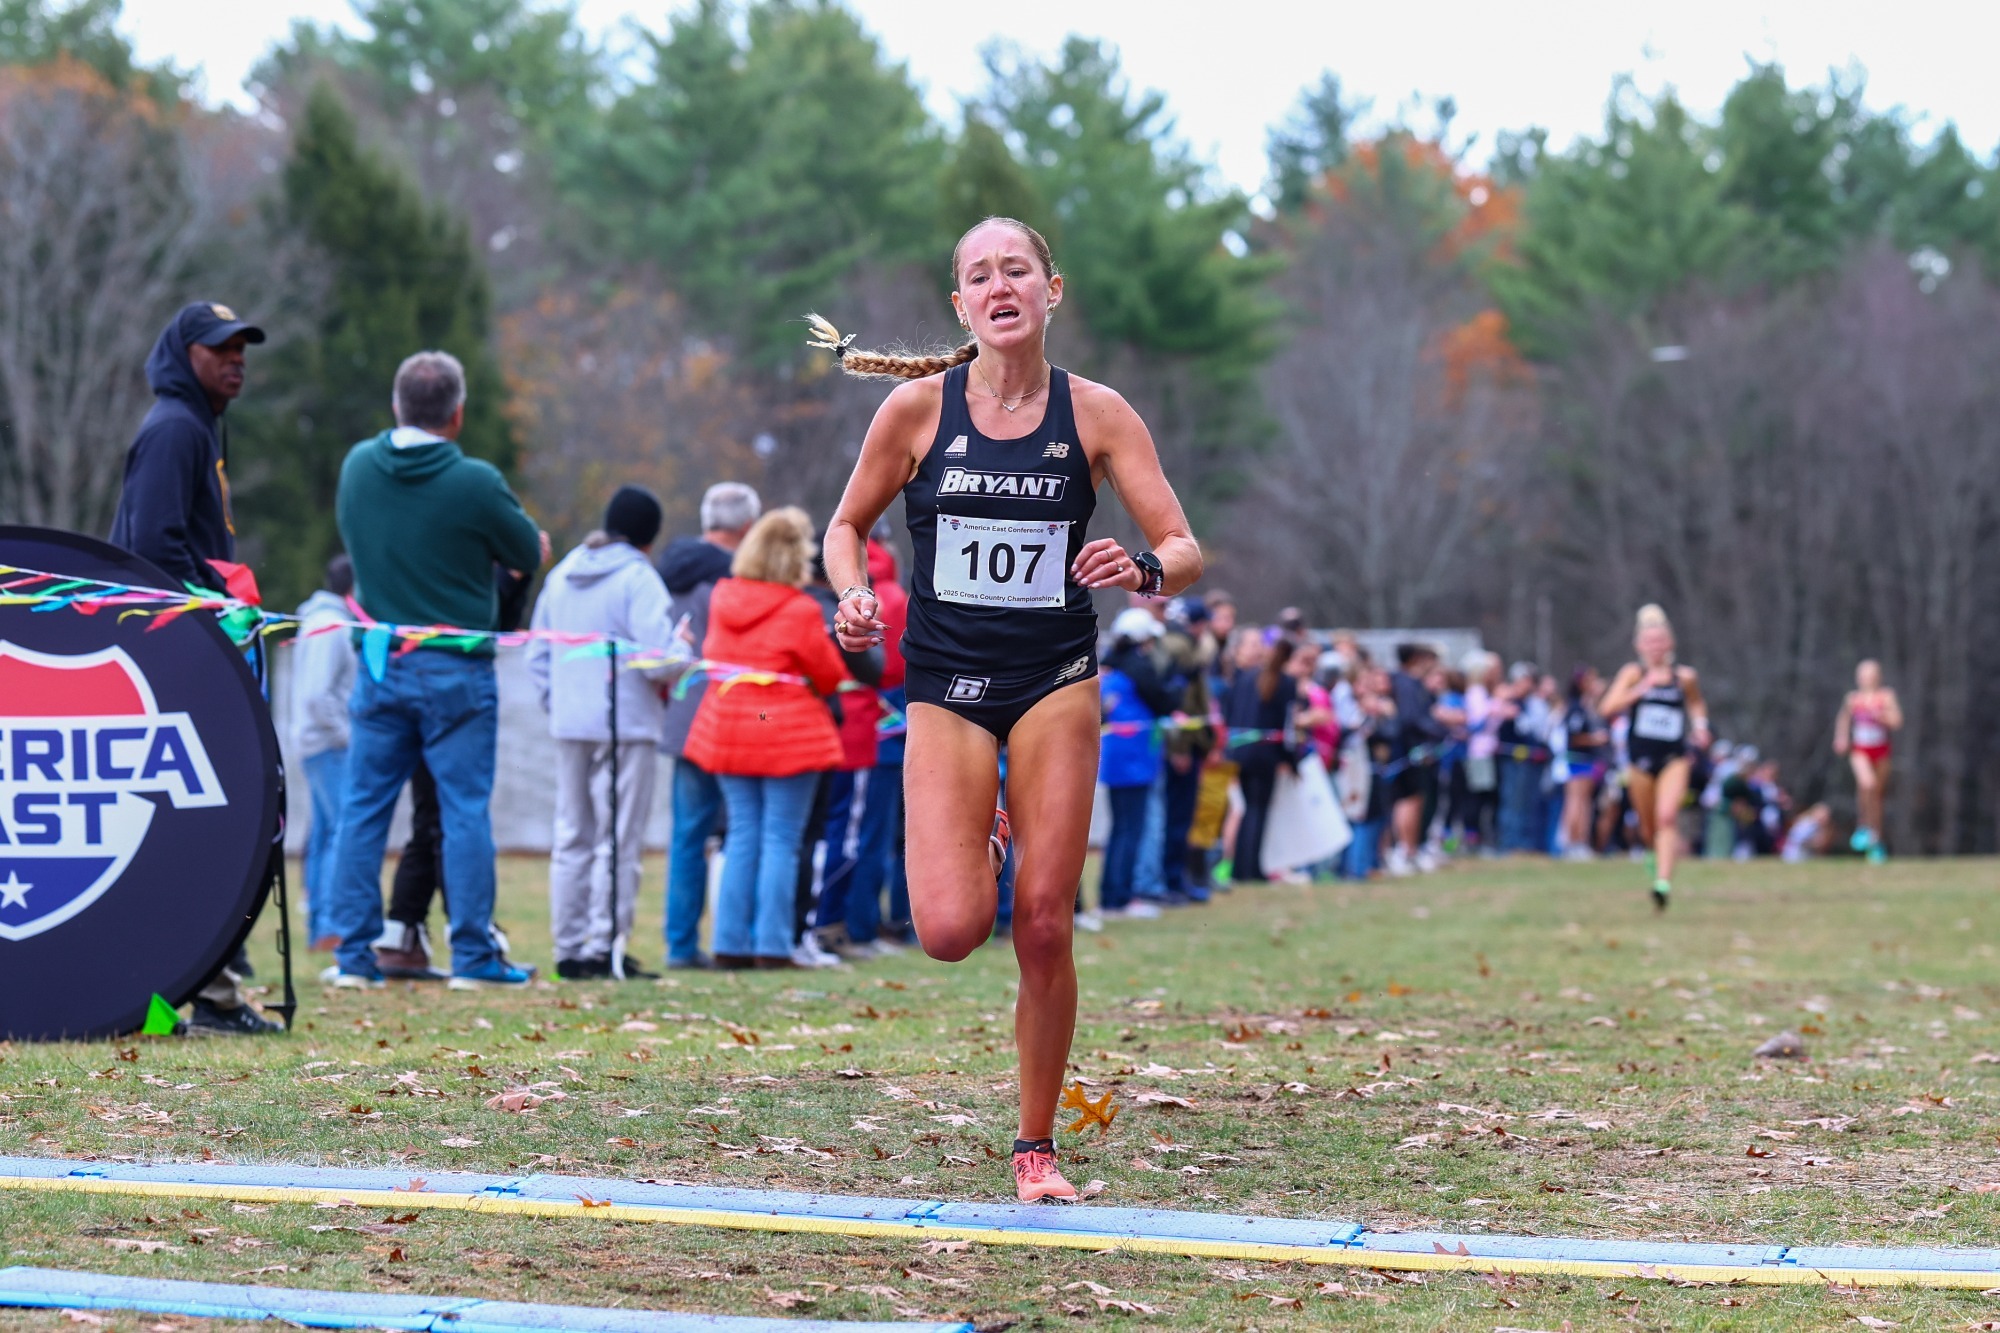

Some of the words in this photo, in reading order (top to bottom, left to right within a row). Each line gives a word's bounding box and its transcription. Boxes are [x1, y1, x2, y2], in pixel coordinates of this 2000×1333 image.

[963, 523, 991, 532] America
[991, 525, 1007, 533] East
[1007, 526, 1044, 534] Conference
[961, 540, 1047, 584] 107
[943, 589, 959, 597] 2025
[959, 591, 979, 600] Cross
[979, 593, 1006, 602] Country
[1007, 594, 1055, 604] Championships
[951, 678, 983, 699] B
[0, 727, 206, 794] RICA
